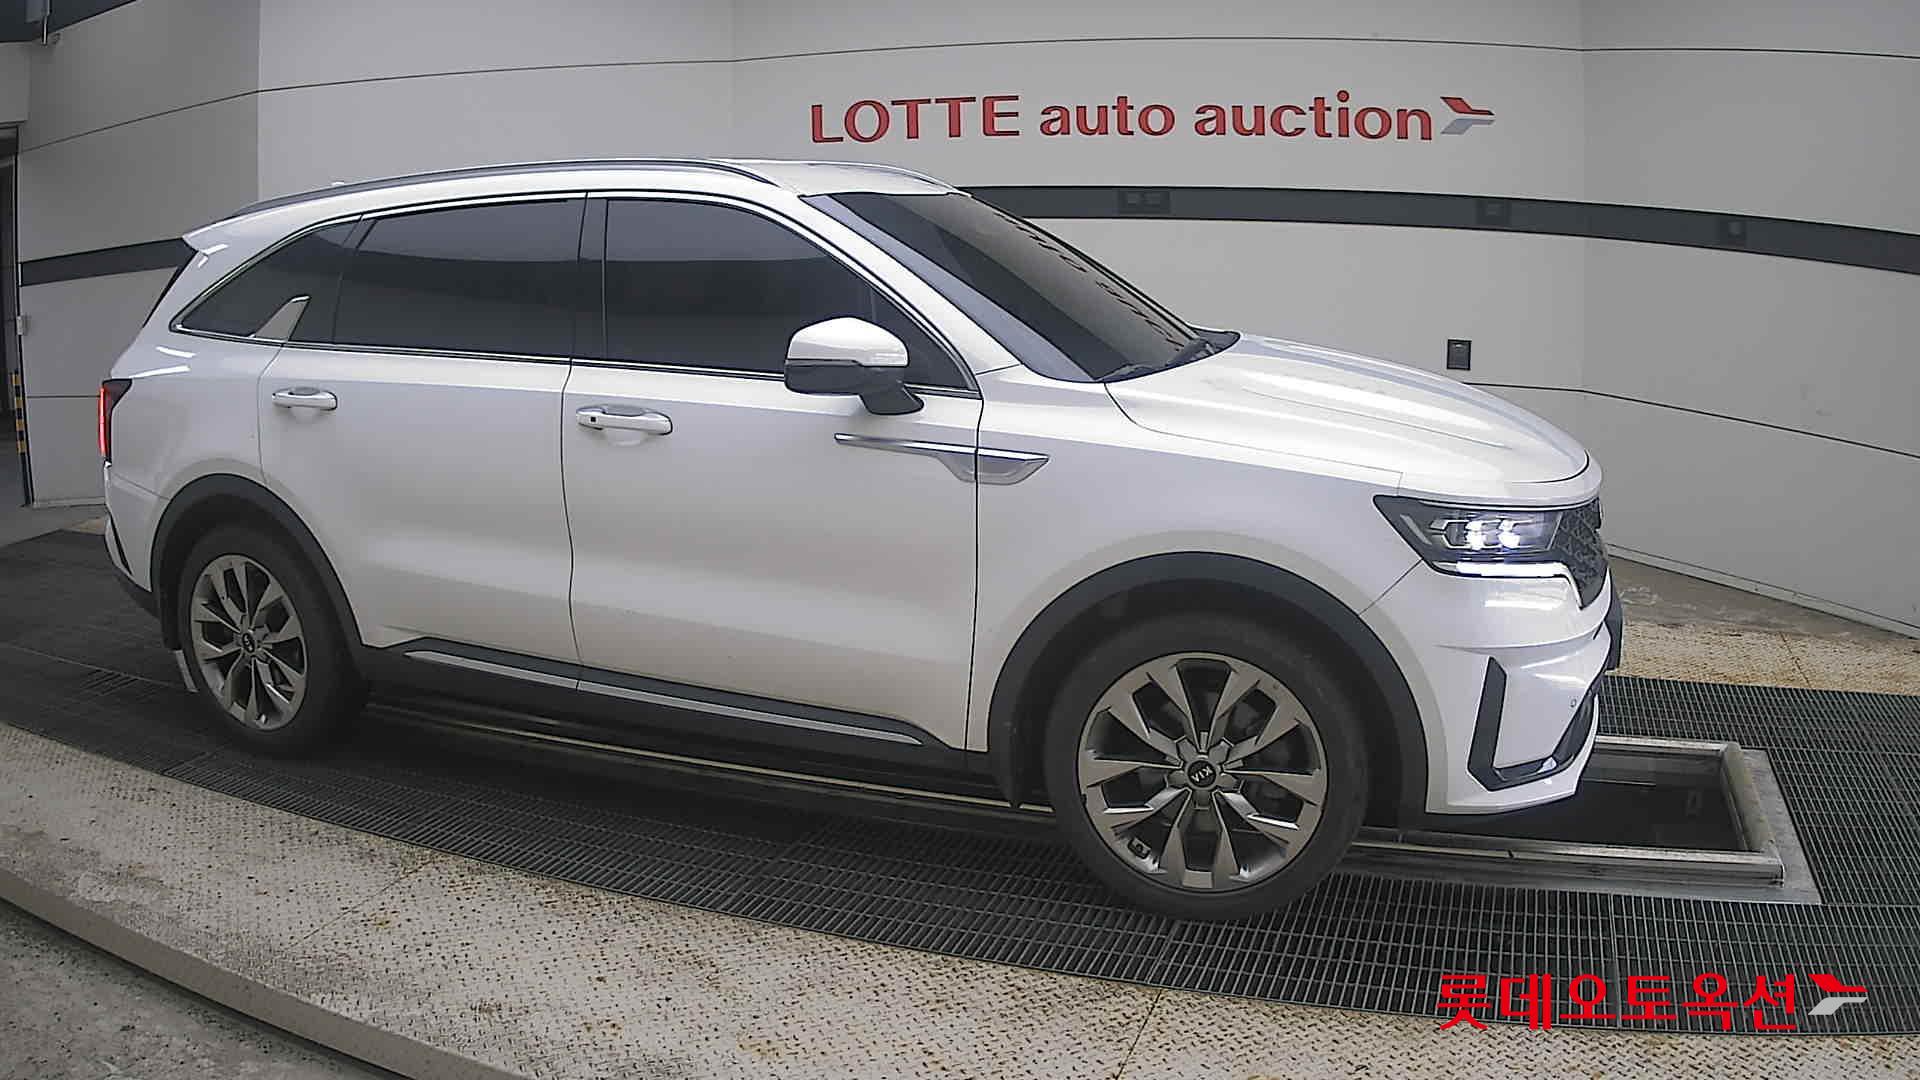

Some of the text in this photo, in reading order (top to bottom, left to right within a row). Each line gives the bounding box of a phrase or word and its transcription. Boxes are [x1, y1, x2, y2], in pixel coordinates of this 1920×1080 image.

[810, 90, 1433, 143] LOTTE auto auction
